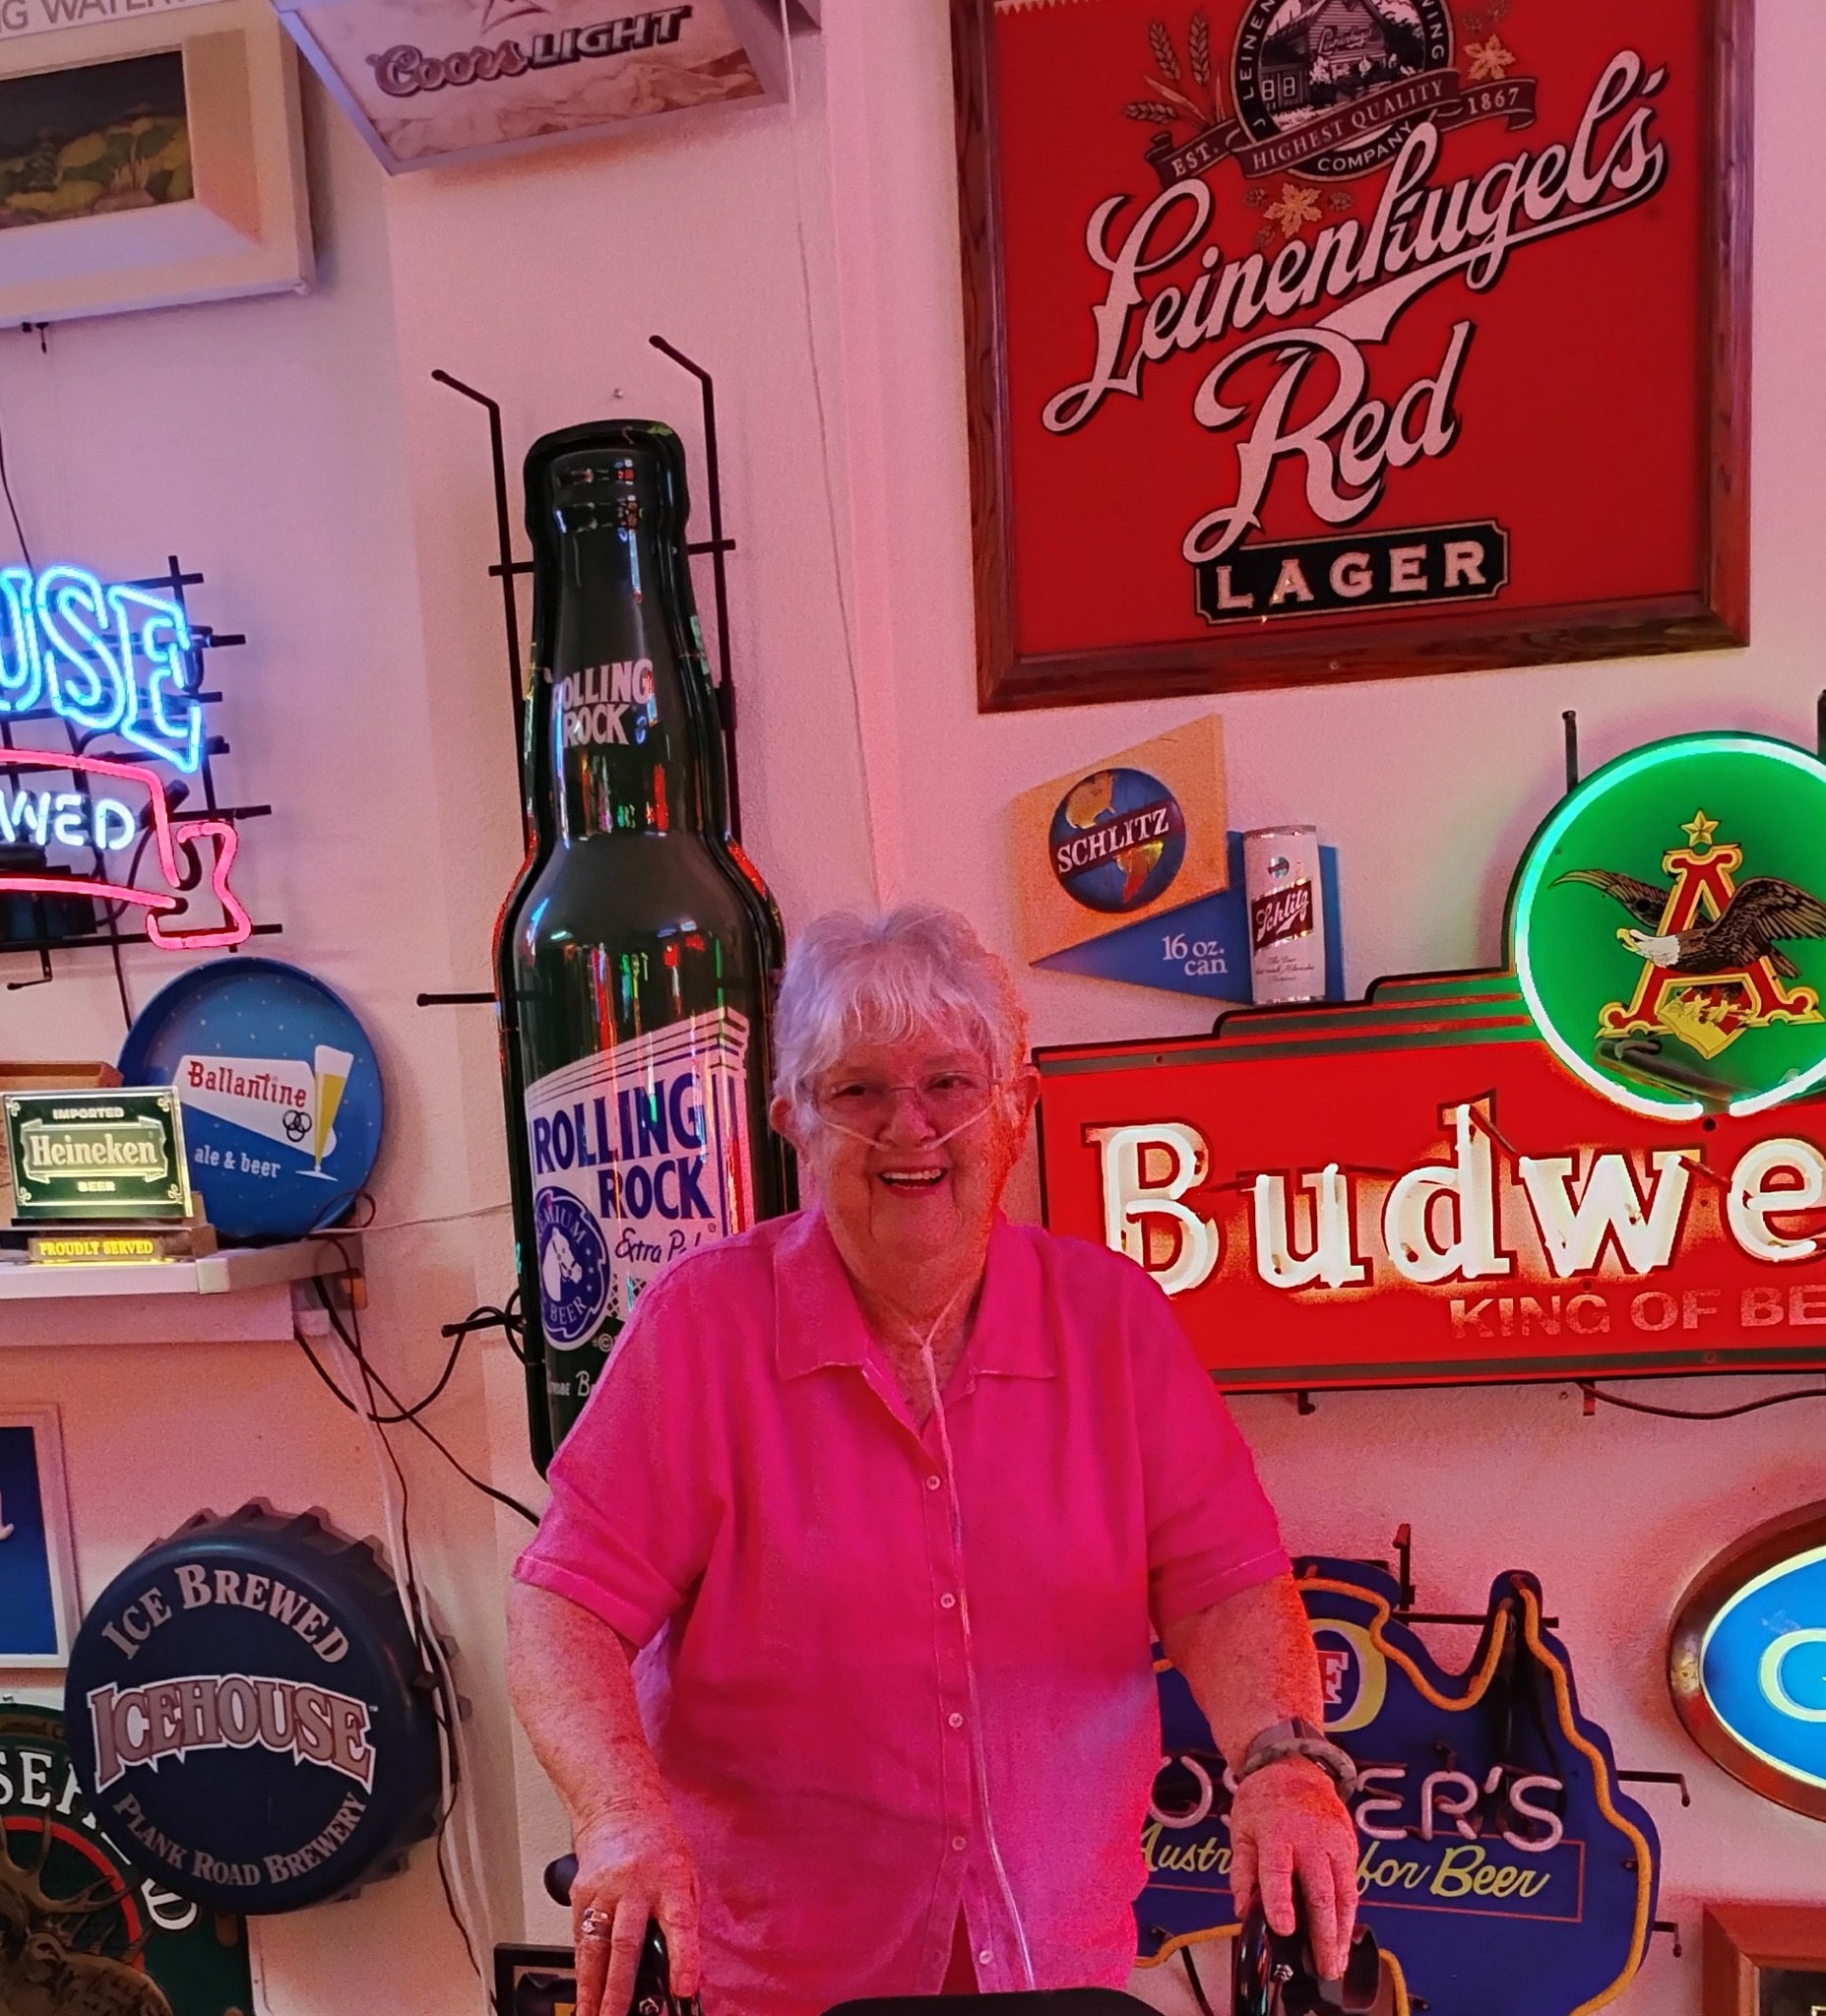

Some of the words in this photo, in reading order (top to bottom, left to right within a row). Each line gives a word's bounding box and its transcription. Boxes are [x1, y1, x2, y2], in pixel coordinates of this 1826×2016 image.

[365, 40, 529, 97] Coors
[528, 5, 693, 69] LIGHT
[1252, 124, 1344, 170] HIGHEST
[1352, 80, 1444, 128] QUALITY
[1468, 88, 1521, 116] 1867
[1170, 145, 1221, 178] EST.
[1317, 121, 1414, 172] COMPANY
[1042, 49, 1667, 432] Leinenkugel's
[1183, 320, 1472, 564] Red
[1217, 540, 1487, 611] LAGER
[562, 703, 631, 749] ROCK
[1056, 807, 1170, 874] SCHLITZ
[1256, 889, 1309, 943] Schlitz
[1162, 933, 1188, 962] 16
[1192, 939, 1226, 956] oz.
[1183, 958, 1228, 976] can
[187, 1060, 307, 1108] Ballantine
[52, 1105, 125, 1121] IMPORTED
[533, 1073, 709, 1175] ROLLING
[30, 1133, 158, 1167] Heineken
[195, 1144, 220, 1165] ale
[223, 1153, 236, 1171] &
[240, 1152, 282, 1179] beer
[78, 1179, 116, 1194] BEER
[597, 1153, 717, 1221] ROCK
[1085, 1089, 1826, 1295] Budwe
[38, 1240, 99, 1257] PROUDLY
[102, 1240, 155, 1256] SERVED
[614, 1227, 662, 1264] Extra
[549, 1295, 588, 1326] BEER
[1449, 1292, 1611, 1340] KING
[1629, 1288, 1722, 1332] OF
[1741, 1285, 1826, 1328] BE
[101, 1587, 172, 1661] ICE
[174, 1564, 349, 1665] BREWED
[87, 1673, 376, 1795] ICEHOUSE
[1150, 1755, 1563, 1852] OER'S
[112, 1793, 187, 1868] PLANK
[192, 1851, 261, 1887] ROAD
[266, 1791, 367, 1883] BREWERY
[1141, 1823, 1232, 1875] Austr
[1357, 1841, 1430, 1896] for
[1430, 1844, 1550, 1900] Beer
